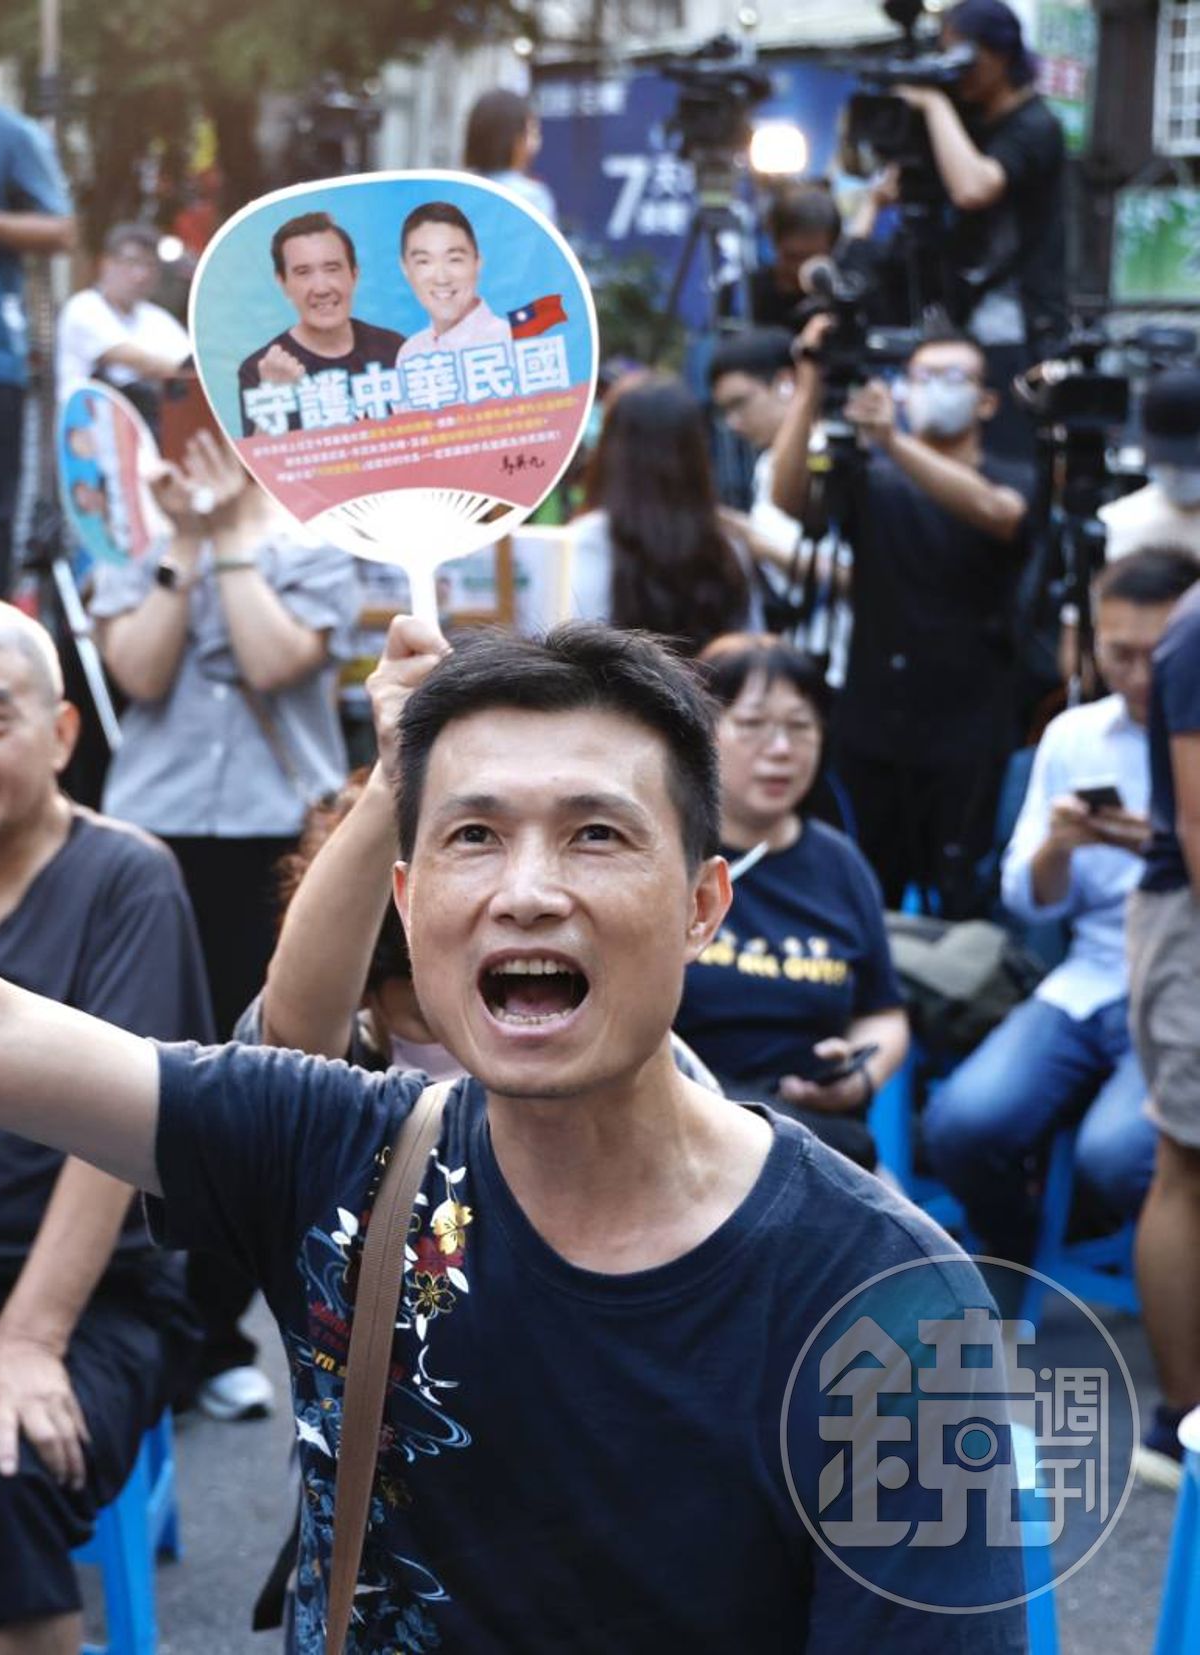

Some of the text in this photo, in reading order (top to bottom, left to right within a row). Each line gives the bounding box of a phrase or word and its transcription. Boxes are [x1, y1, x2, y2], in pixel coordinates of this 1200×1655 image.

[243, 335, 571, 437] 守護中華民國
